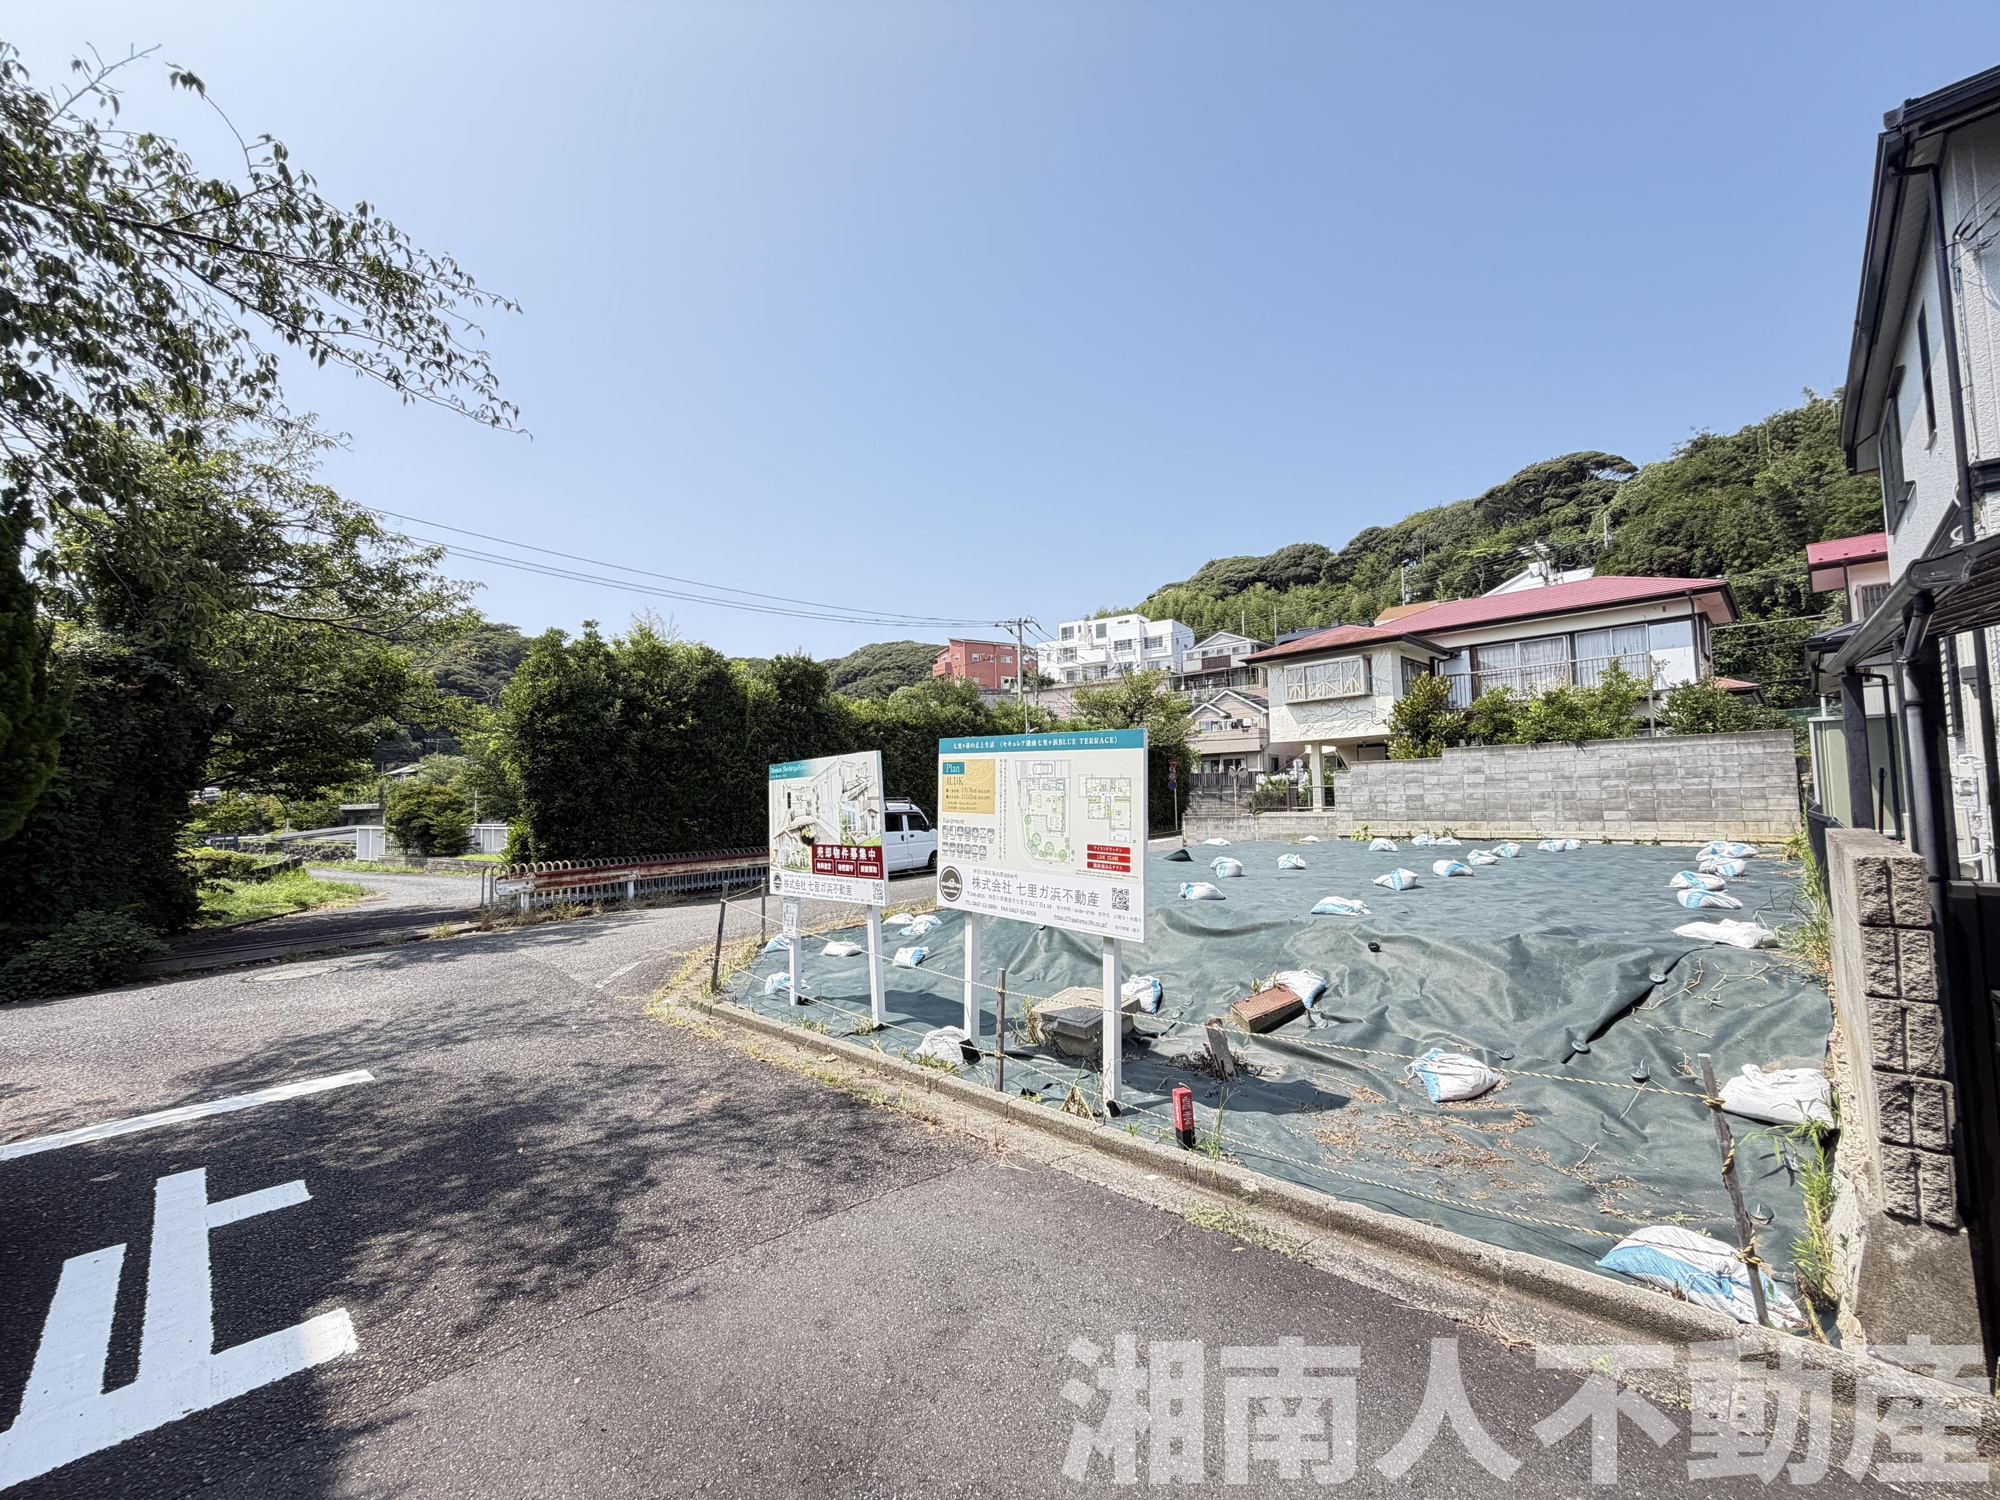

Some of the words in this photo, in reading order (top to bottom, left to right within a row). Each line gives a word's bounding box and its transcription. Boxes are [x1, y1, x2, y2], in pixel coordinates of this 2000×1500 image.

[946, 763, 960, 773] Plan
[946, 776, 964, 786] 4LDK
[816, 846, 876, 861] 売却物件募集中
[783, 879, 807, 891] 株式会社
[808, 880, 853, 897] 七里ガ浜不動産
[972, 875, 1013, 895] 株式会社
[1016, 881, 1100, 908] 七里ガ浜不動産
[0, 1167, 359, 1491] 止
